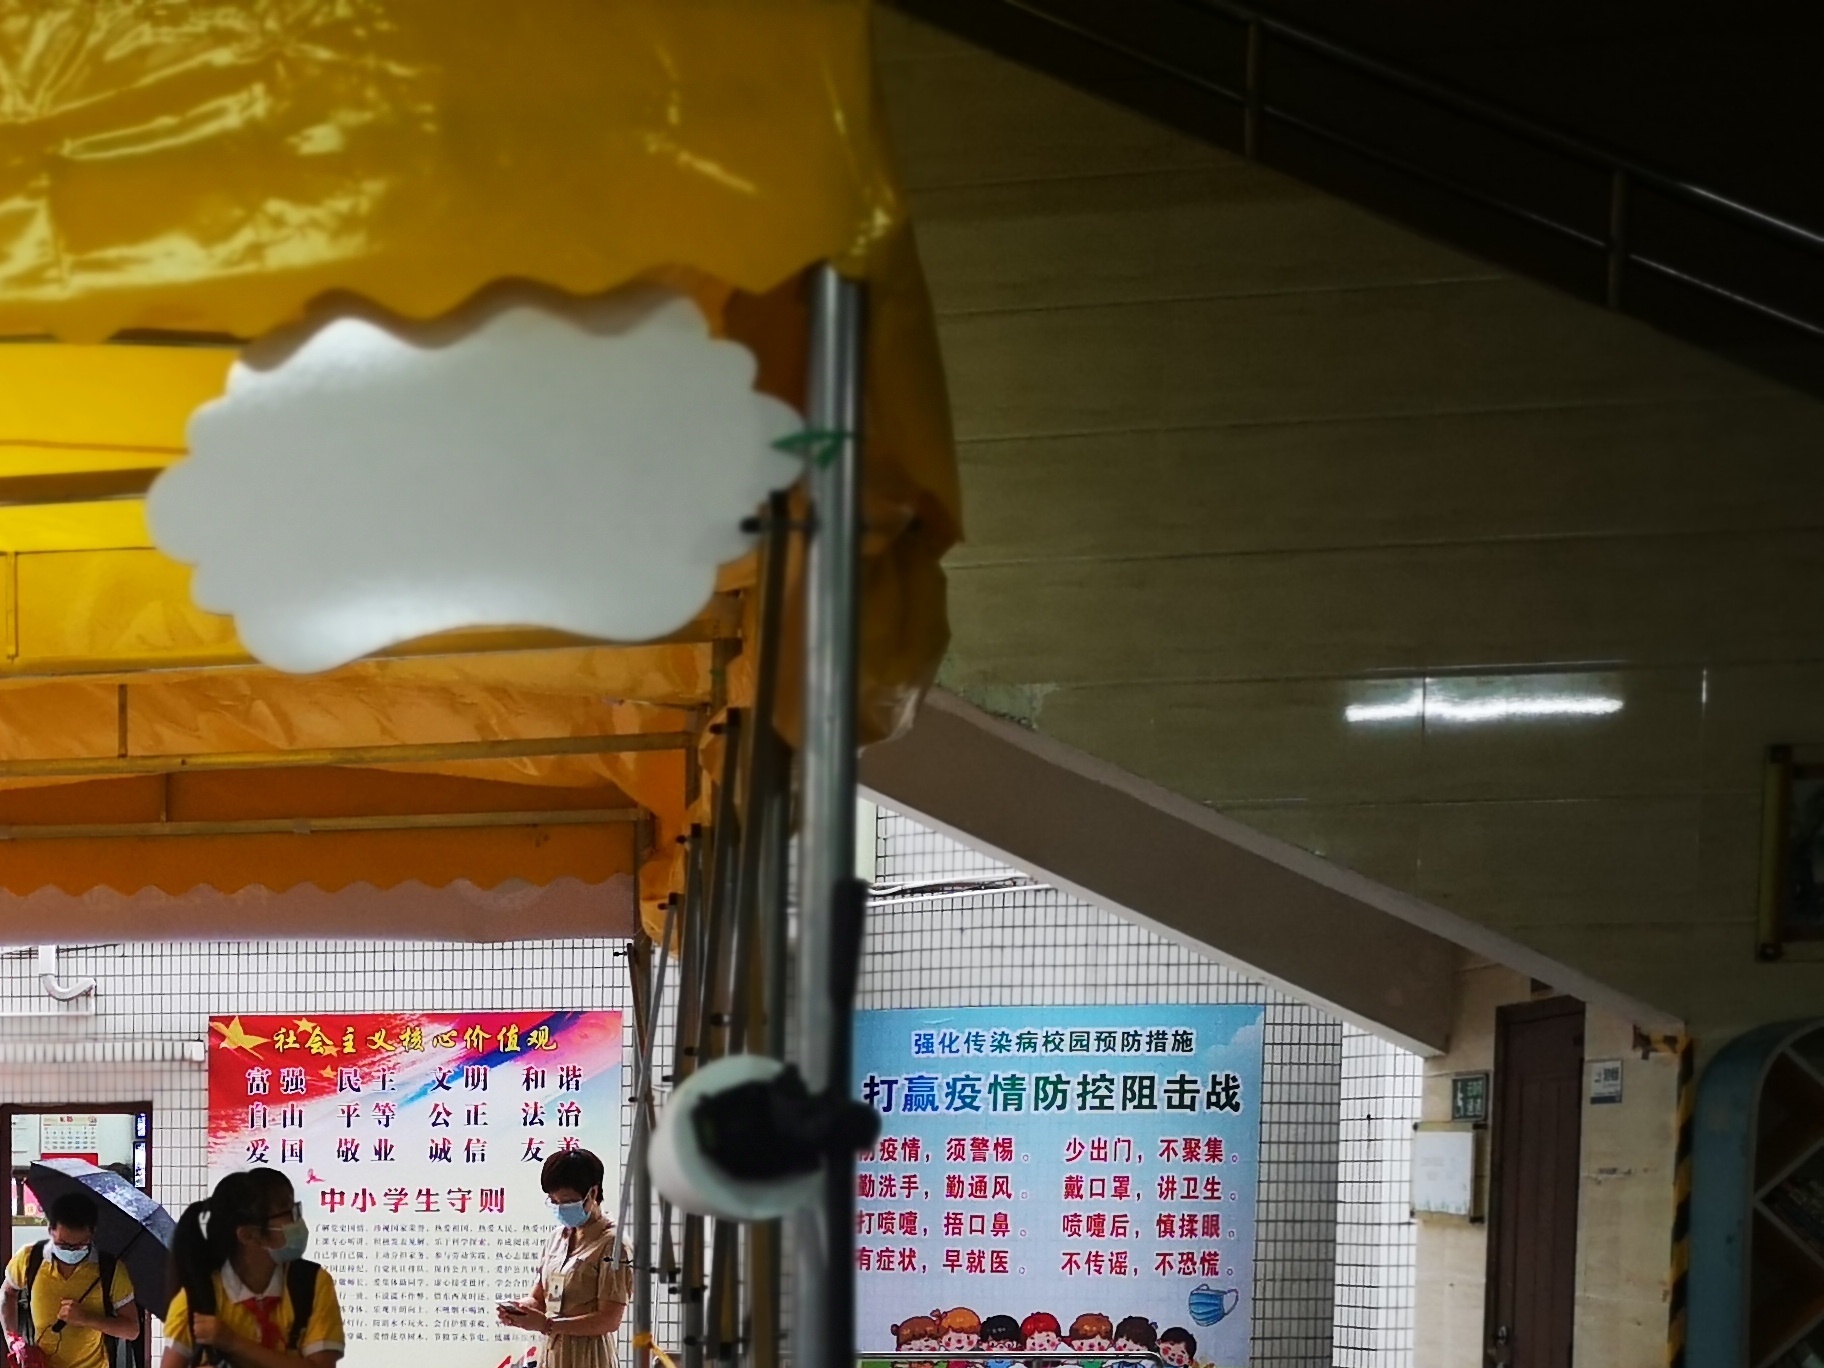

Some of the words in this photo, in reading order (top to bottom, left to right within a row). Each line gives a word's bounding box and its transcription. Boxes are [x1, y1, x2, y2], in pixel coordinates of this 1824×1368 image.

[273, 1024, 558, 1054] 社会主义核心价值观
[913, 1030, 1195, 1055] 强化传染病校园预防措施
[246, 1068, 305, 1094] 富强
[338, 1068, 396, 1093] 民主
[430, 1066, 489, 1091] 文明
[522, 1065, 582, 1091] 和谐
[863, 1074, 1242, 1113] 打赢疫情防控阻击战
[337, 1102, 396, 1128] 平等
[429, 1101, 488, 1127] 公正
[521, 1101, 582, 1127] 法治
[246, 1138, 303, 1163] 爱国
[337, 1138, 395, 1163] 敬业
[429, 1137, 488, 1163] 诚信
[1065, 1137, 1238, 1163] 少出门，不聚集。
[320, 1187, 506, 1215] 中小学生守则
[1064, 1175, 1237, 1201] 戴口罩，讲卫生。
[1062, 1213, 1235, 1239] 喷嚏后，慎揉眼。
[1061, 1250, 1233, 1276] 不传谣，不恐慌。
